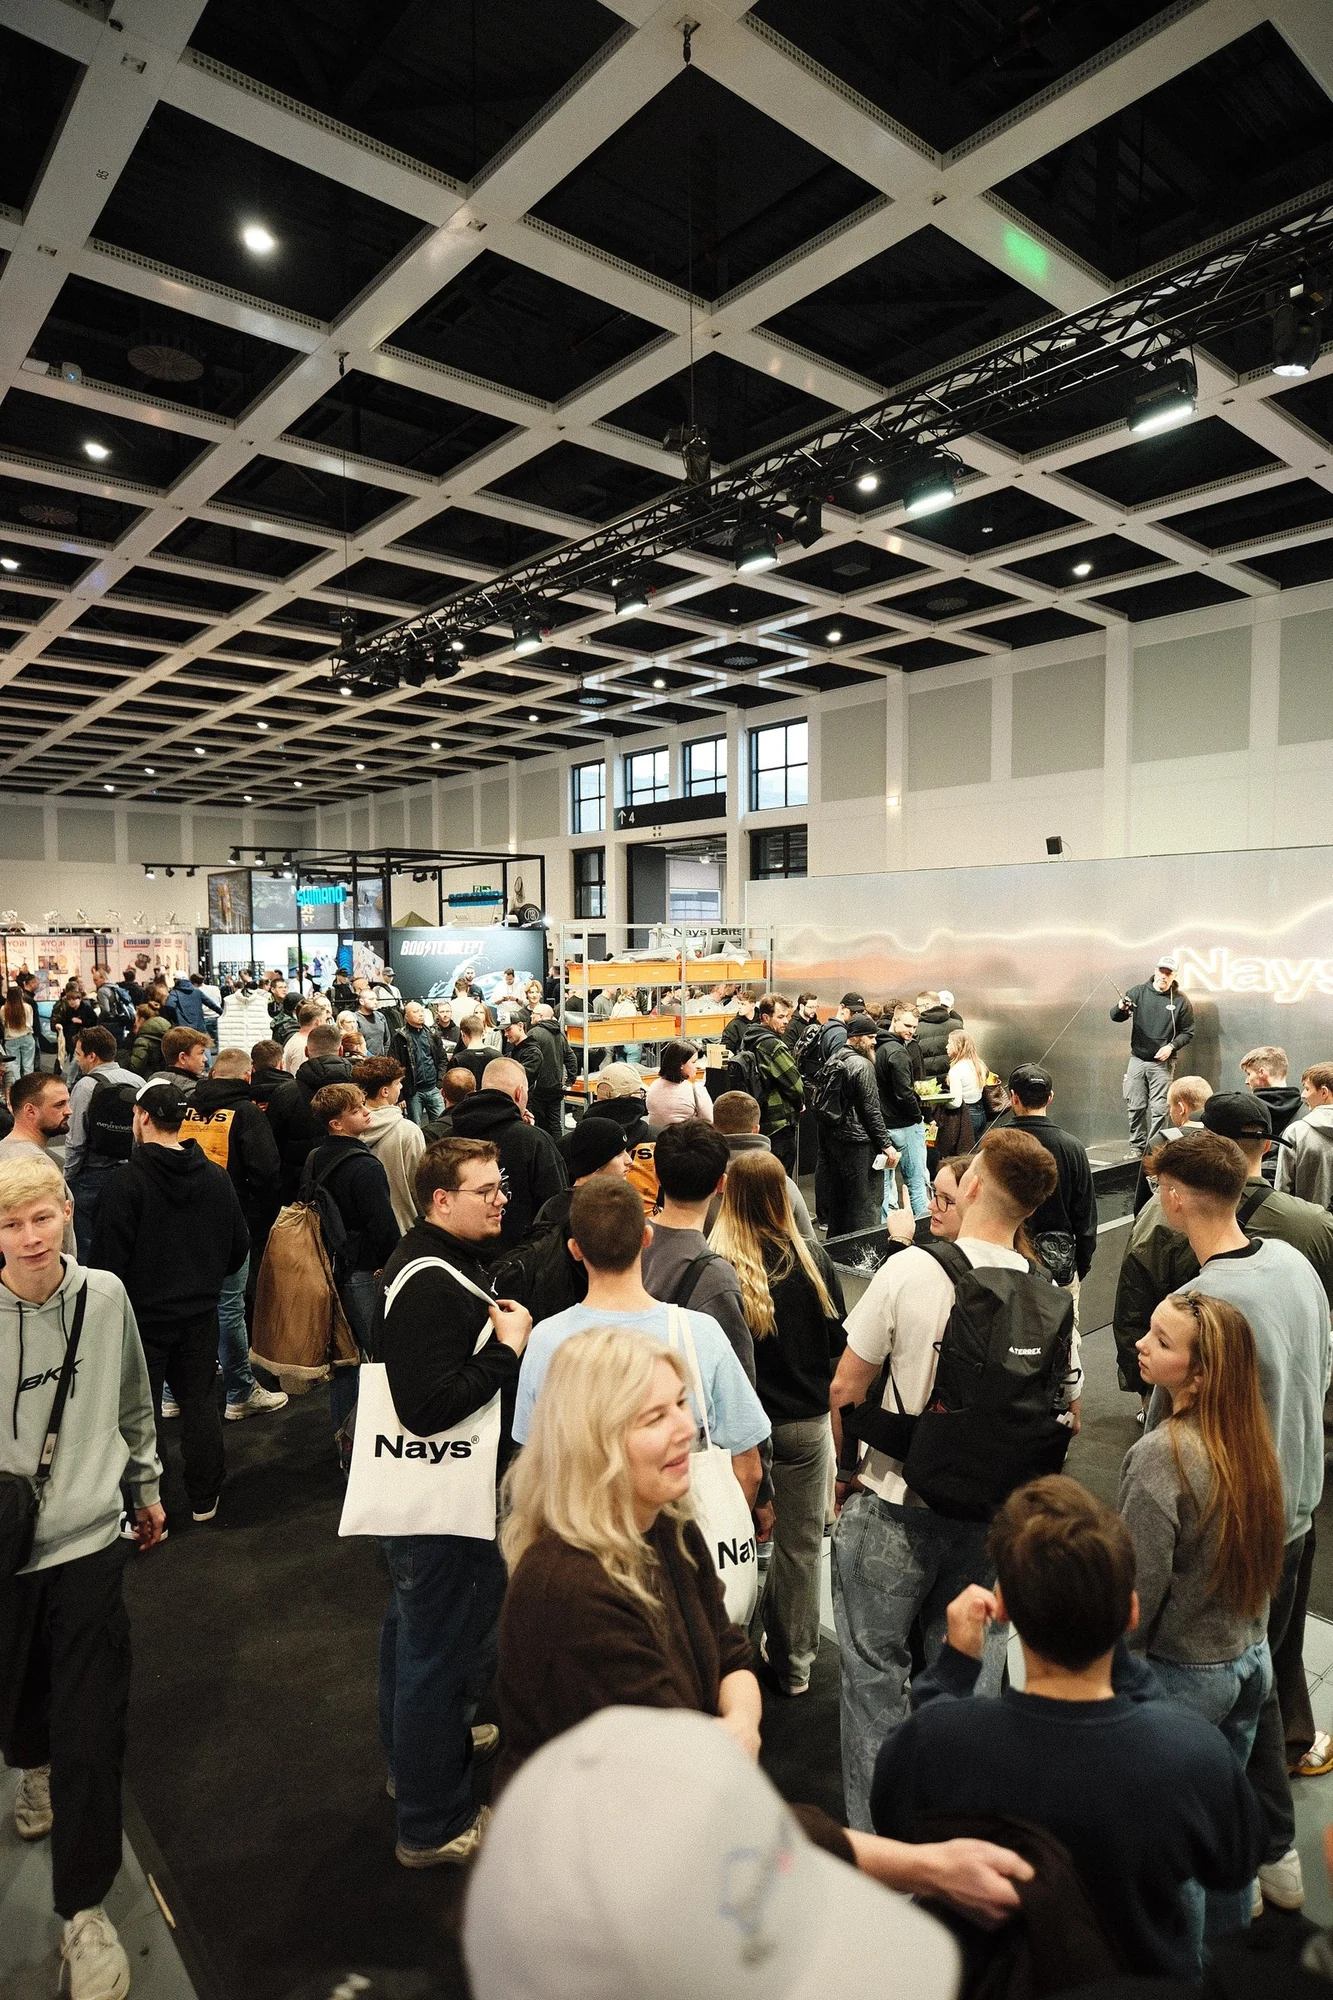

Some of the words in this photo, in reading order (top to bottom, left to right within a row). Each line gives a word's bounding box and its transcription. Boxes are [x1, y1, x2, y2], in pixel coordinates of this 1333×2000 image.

[96, 169, 109, 180] 85
[628, 811, 636, 824] 4
[296, 886, 345, 906] SHIMANO
[673, 928, 707, 938] Nays
[1014, 1346, 1042, 1356] TERREX
